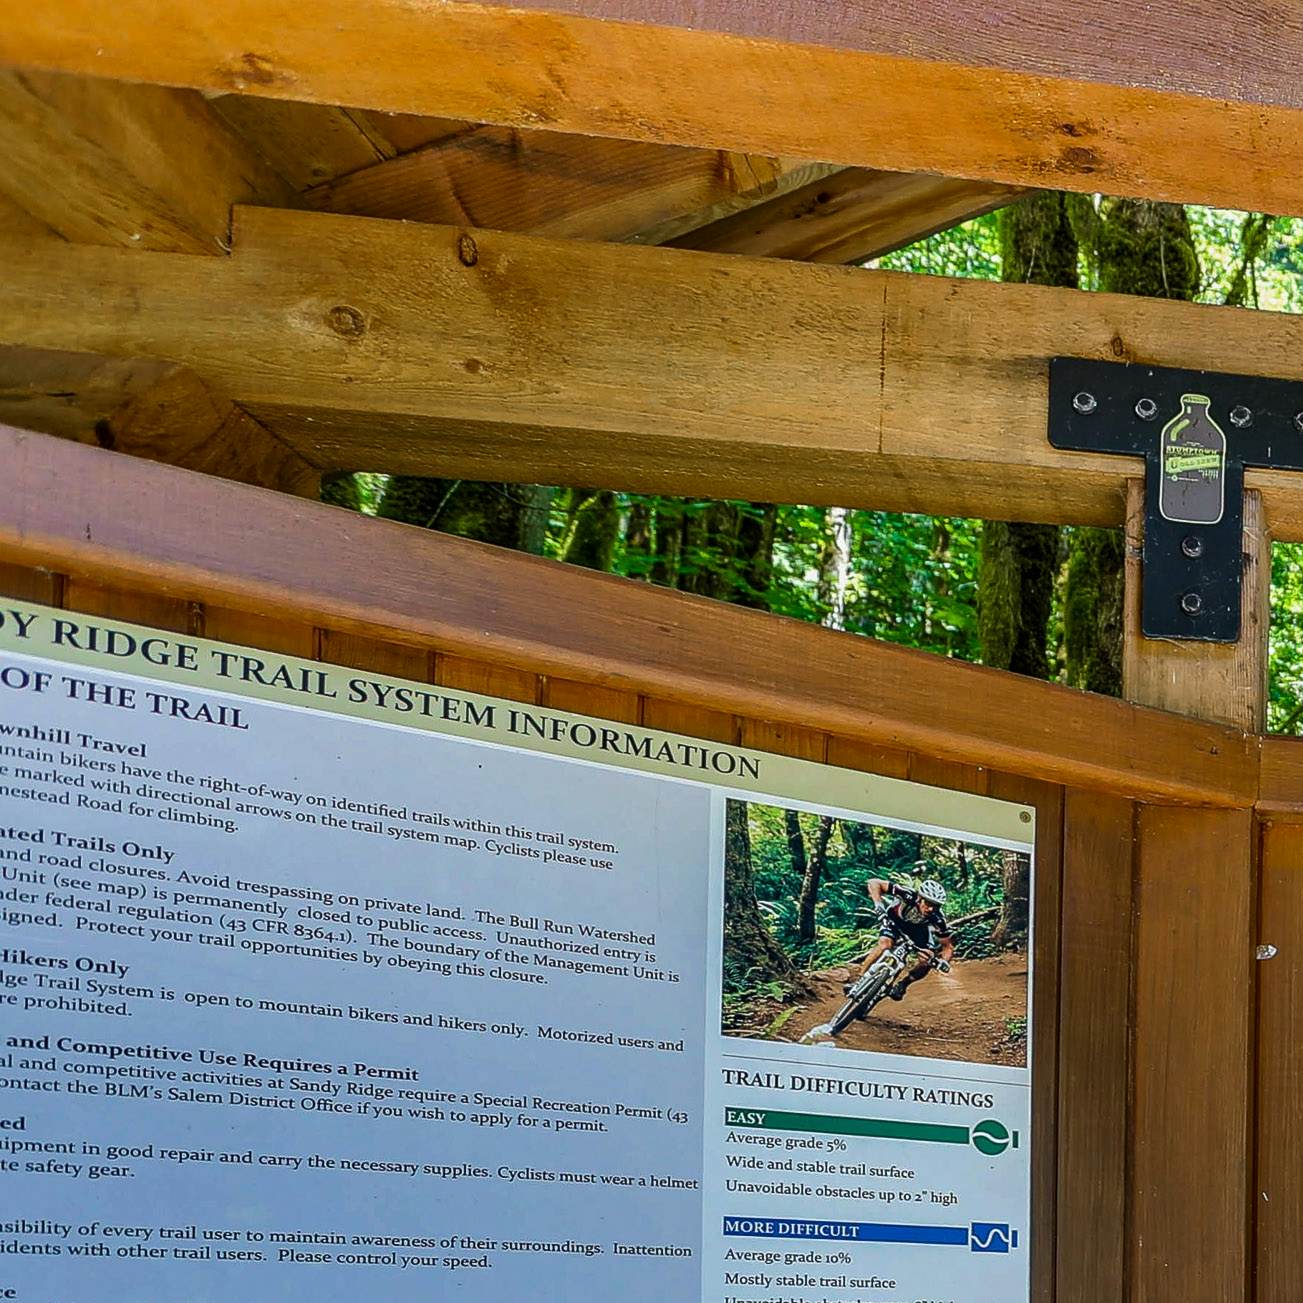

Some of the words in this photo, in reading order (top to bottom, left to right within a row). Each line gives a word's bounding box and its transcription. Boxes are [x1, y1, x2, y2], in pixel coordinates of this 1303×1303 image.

[1, 667, 52, 693] OF
[61, 676, 136, 709] THE
[145, 692, 249, 730] TRAIL
[50, 618, 198, 671] RIDGE
[210, 650, 337, 698] TRAIL
[348, 678, 497, 729] SYSTEM
[506, 709, 761, 779] INFORMATION
[721, 1068, 785, 1089] TRAIL
[789, 1075, 909, 1100] DIFFICULTY
[912, 1087, 993, 1108] RATINGS
[727, 1111, 766, 1125] EASY
[725, 1132, 784, 1149] Average
[785, 1135, 824, 1151] grade
[824, 1137, 846, 1153] 5%
[725, 1220, 774, 1234] MORE
[778, 1222, 859, 1237] DIFFICULT
